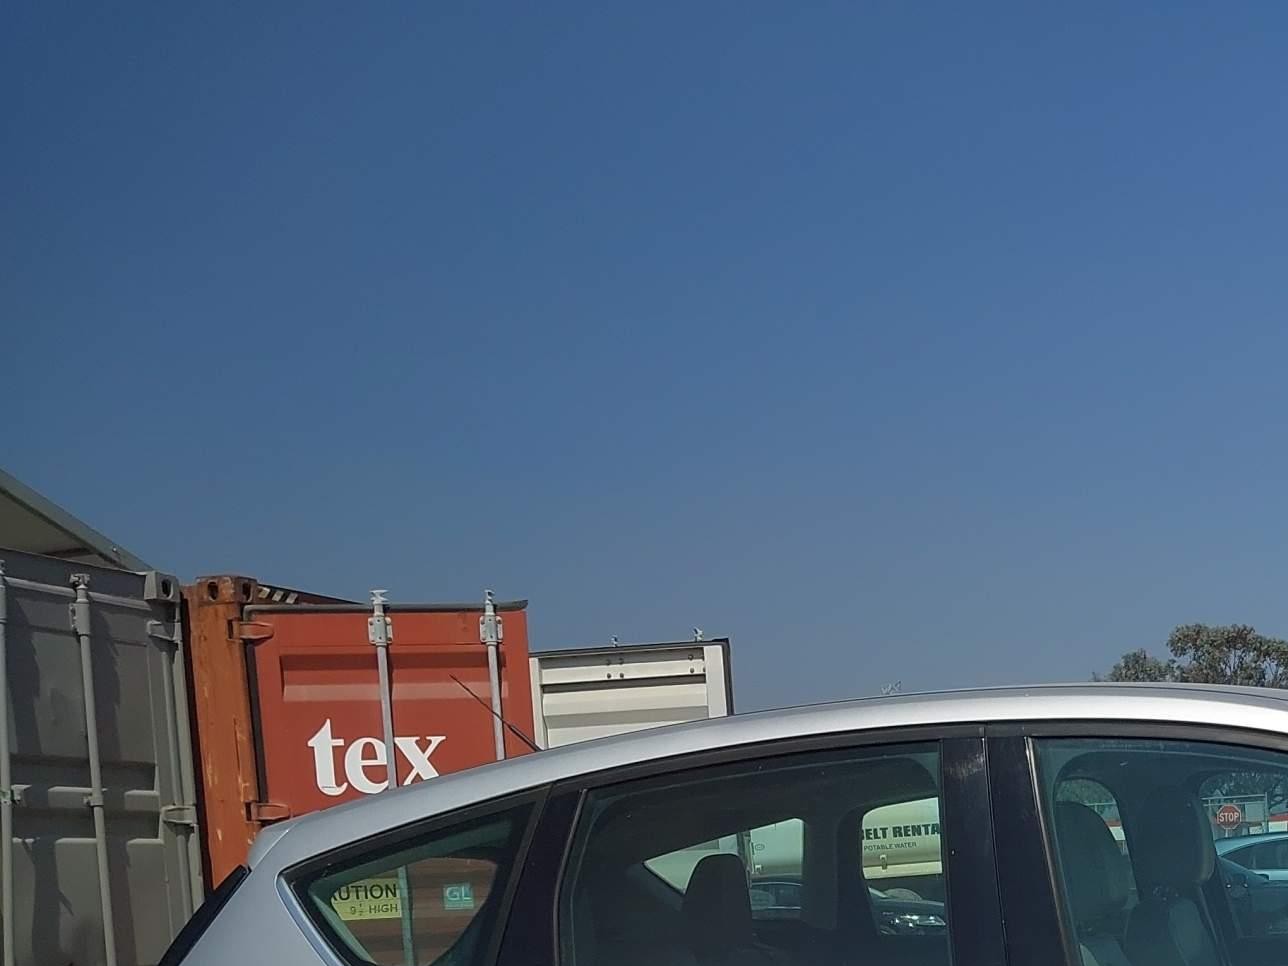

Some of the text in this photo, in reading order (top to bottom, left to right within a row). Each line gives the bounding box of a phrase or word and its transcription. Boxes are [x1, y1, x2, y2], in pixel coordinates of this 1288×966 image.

[308, 718, 446, 796] tex
[1220, 812, 1240, 822] STOP
[862, 827, 888, 840] ELT
[863, 841, 917, 851] POTABLE WATER
[368, 903, 399, 914] HIGH
